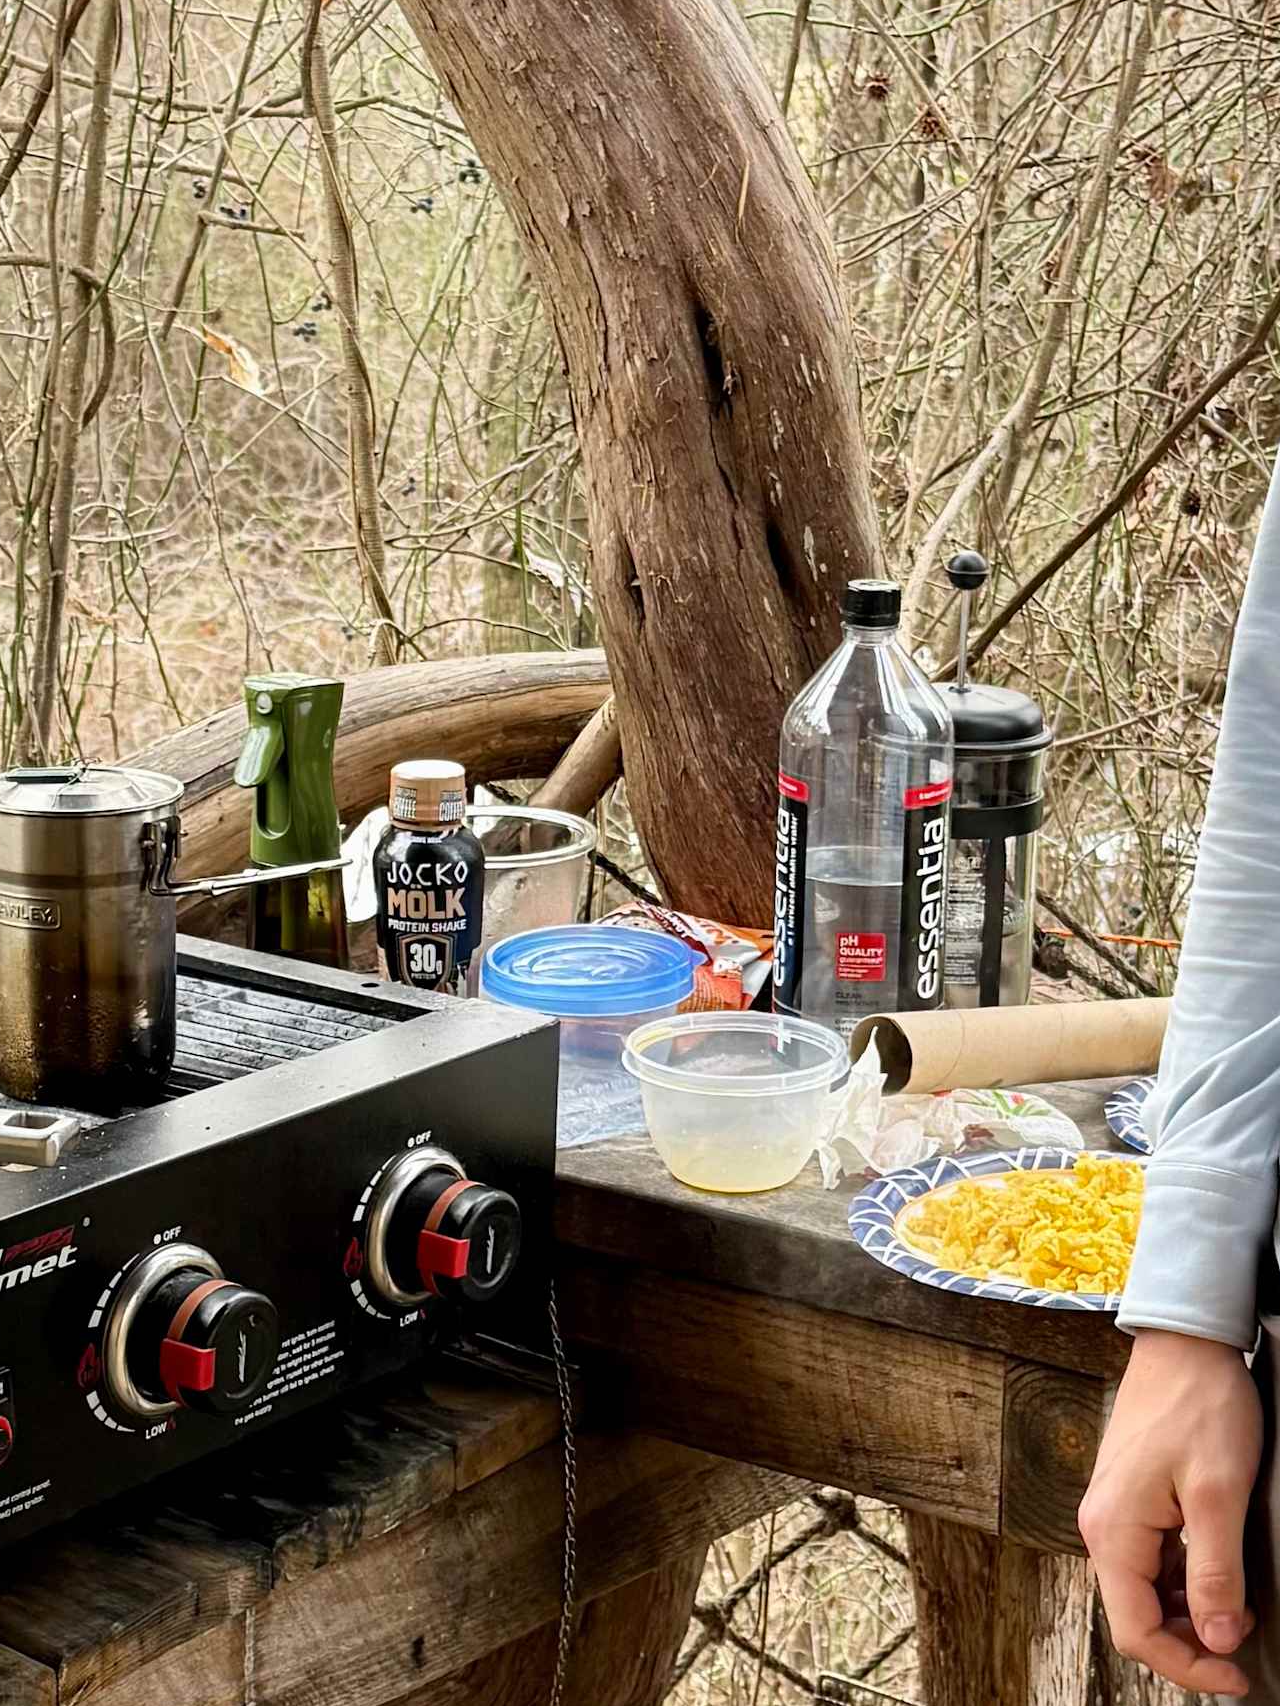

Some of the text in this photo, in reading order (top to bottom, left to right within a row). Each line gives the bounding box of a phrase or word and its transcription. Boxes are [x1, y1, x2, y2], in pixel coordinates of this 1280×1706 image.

[386, 860, 469, 886] JOCKO
[916, 816, 945, 1000] essentia
[387, 918, 467, 933] PROTEIN SHAKE
[839, 935, 859, 947] pH
[839, 947, 883, 957] QUALITY
[415, 1129, 432, 1145] OFF
[163, 1225, 182, 1242] OFF
[399, 1310, 419, 1327] LOW
[145, 1421, 168, 1440] LOW
